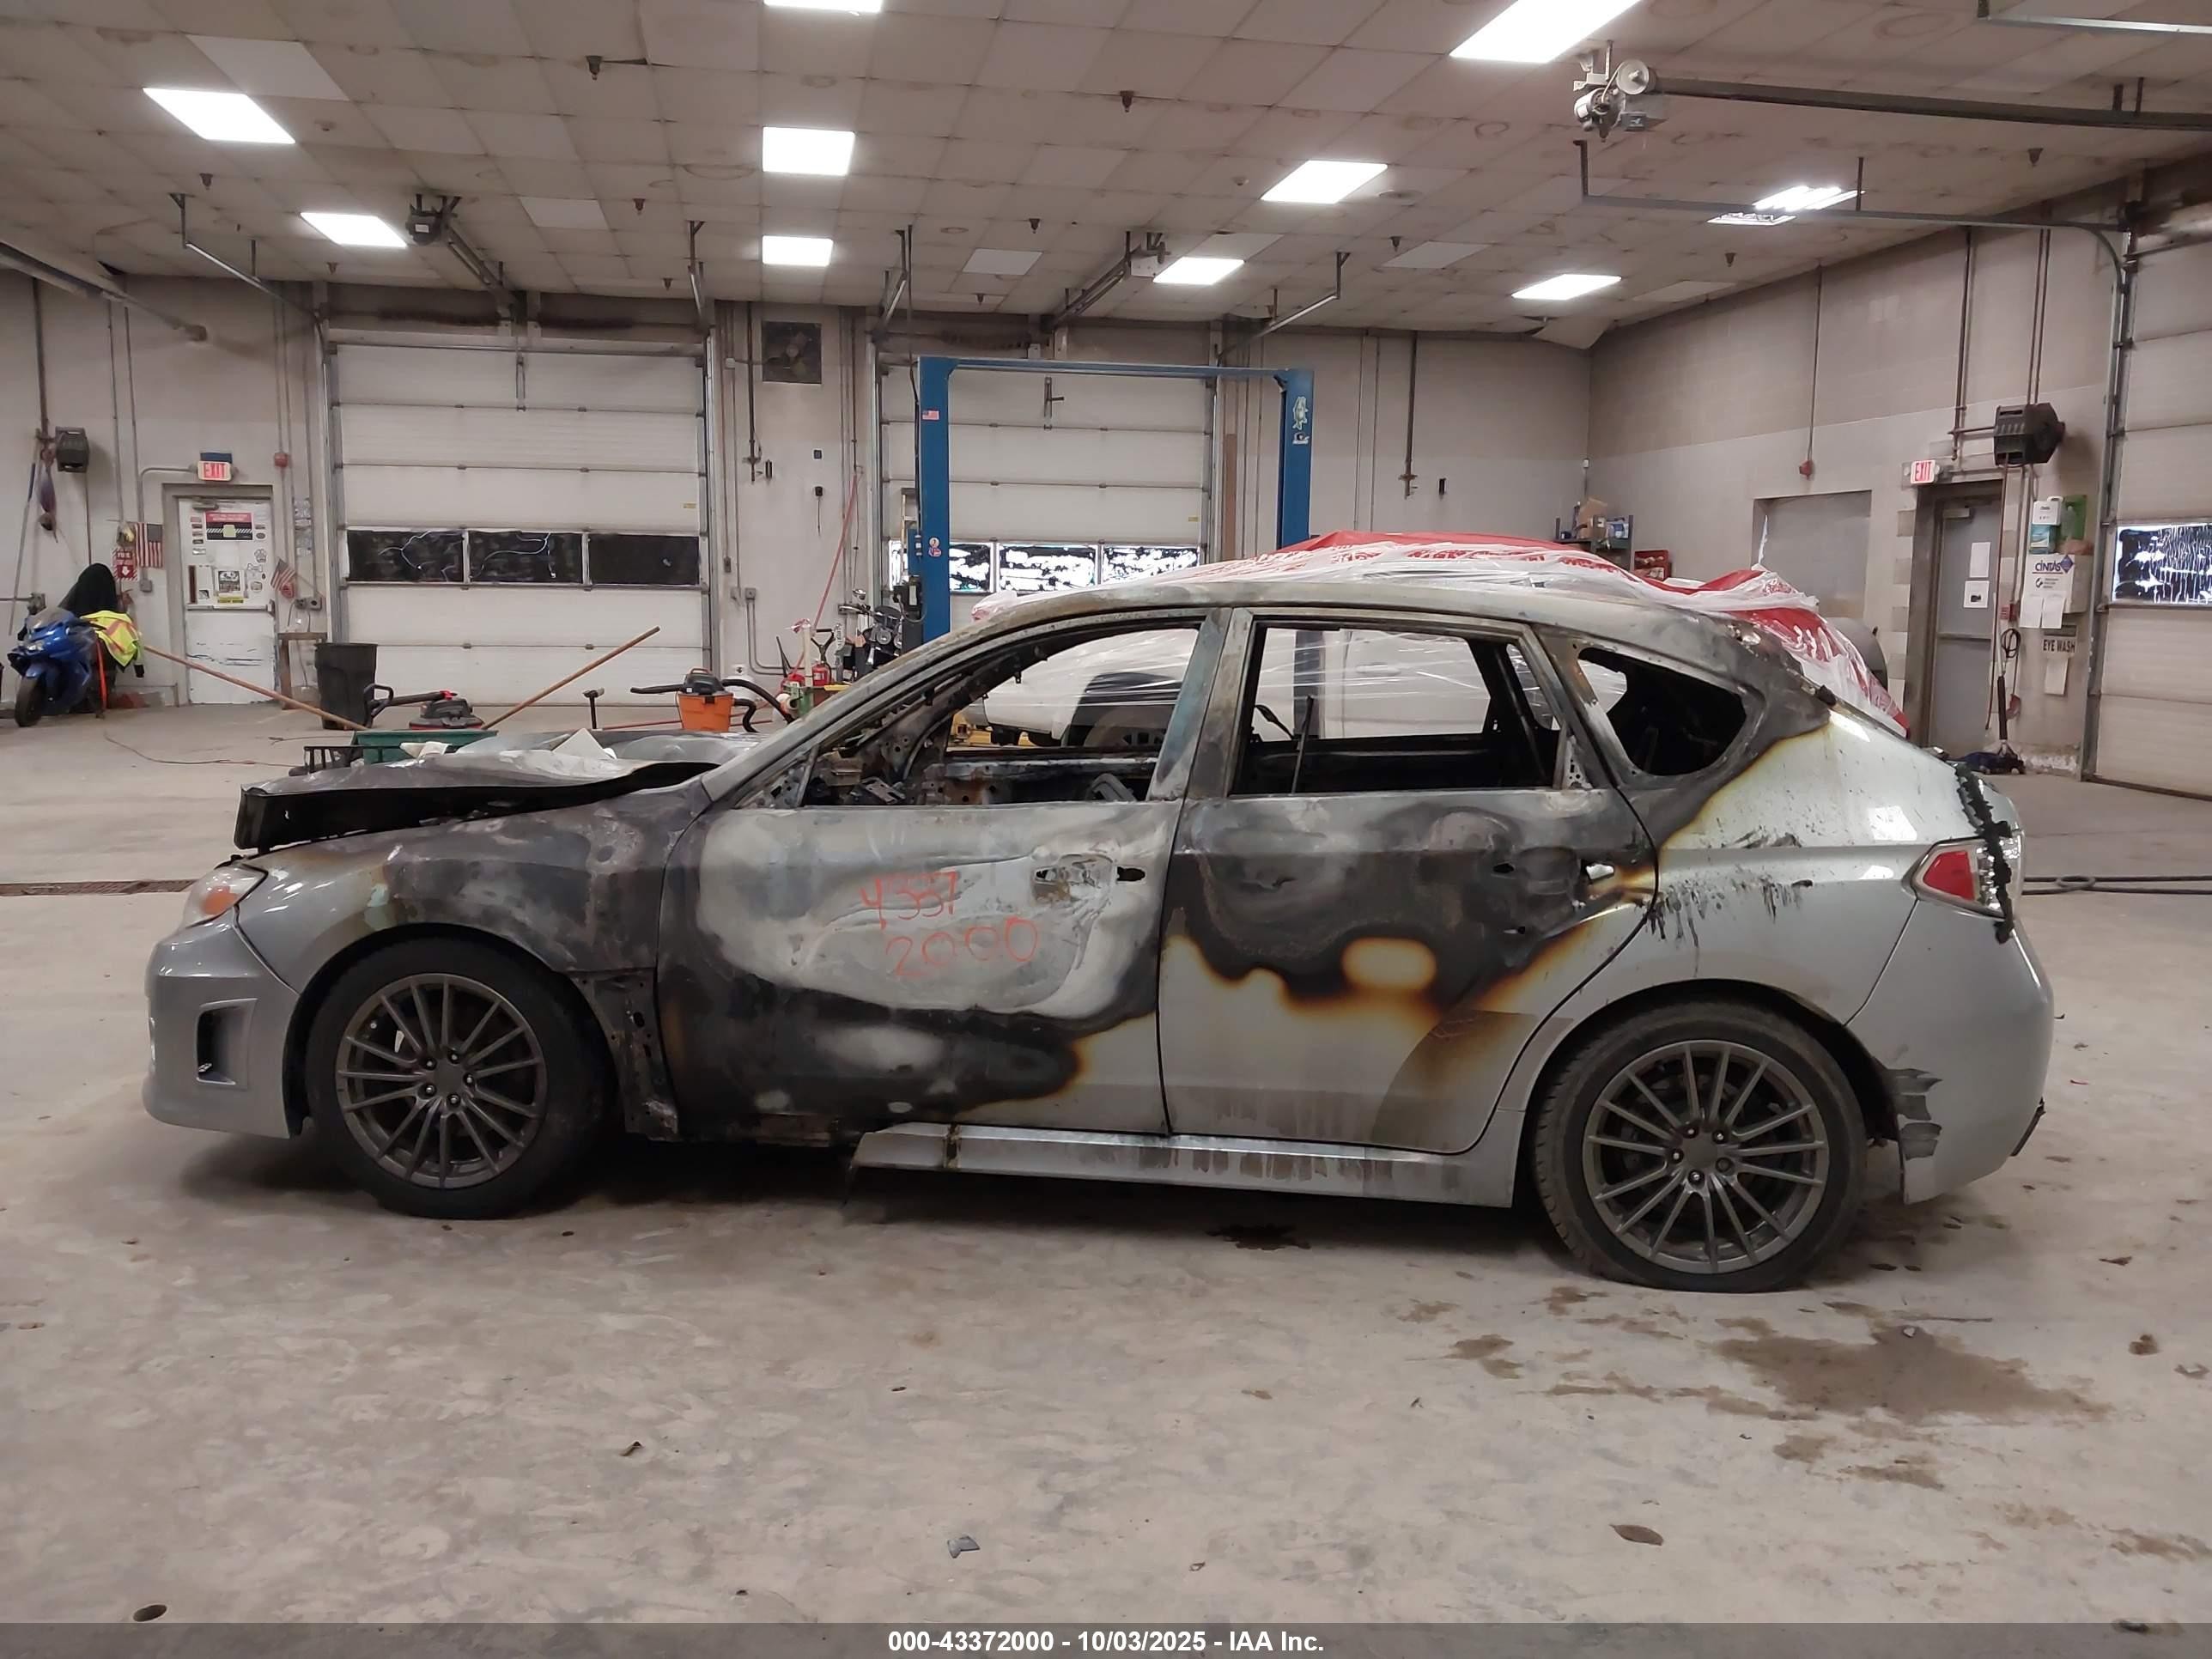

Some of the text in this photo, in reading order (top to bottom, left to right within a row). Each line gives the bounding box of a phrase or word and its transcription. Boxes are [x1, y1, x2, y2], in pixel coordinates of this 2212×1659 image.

[204, 462, 226, 478] EXIT
[1915, 461, 1932, 482] EXIT
[2035, 560, 2062, 572] CINTAS
[2043, 639, 2075, 653] EYE WASH
[885, 915, 1039, 976] 2000
